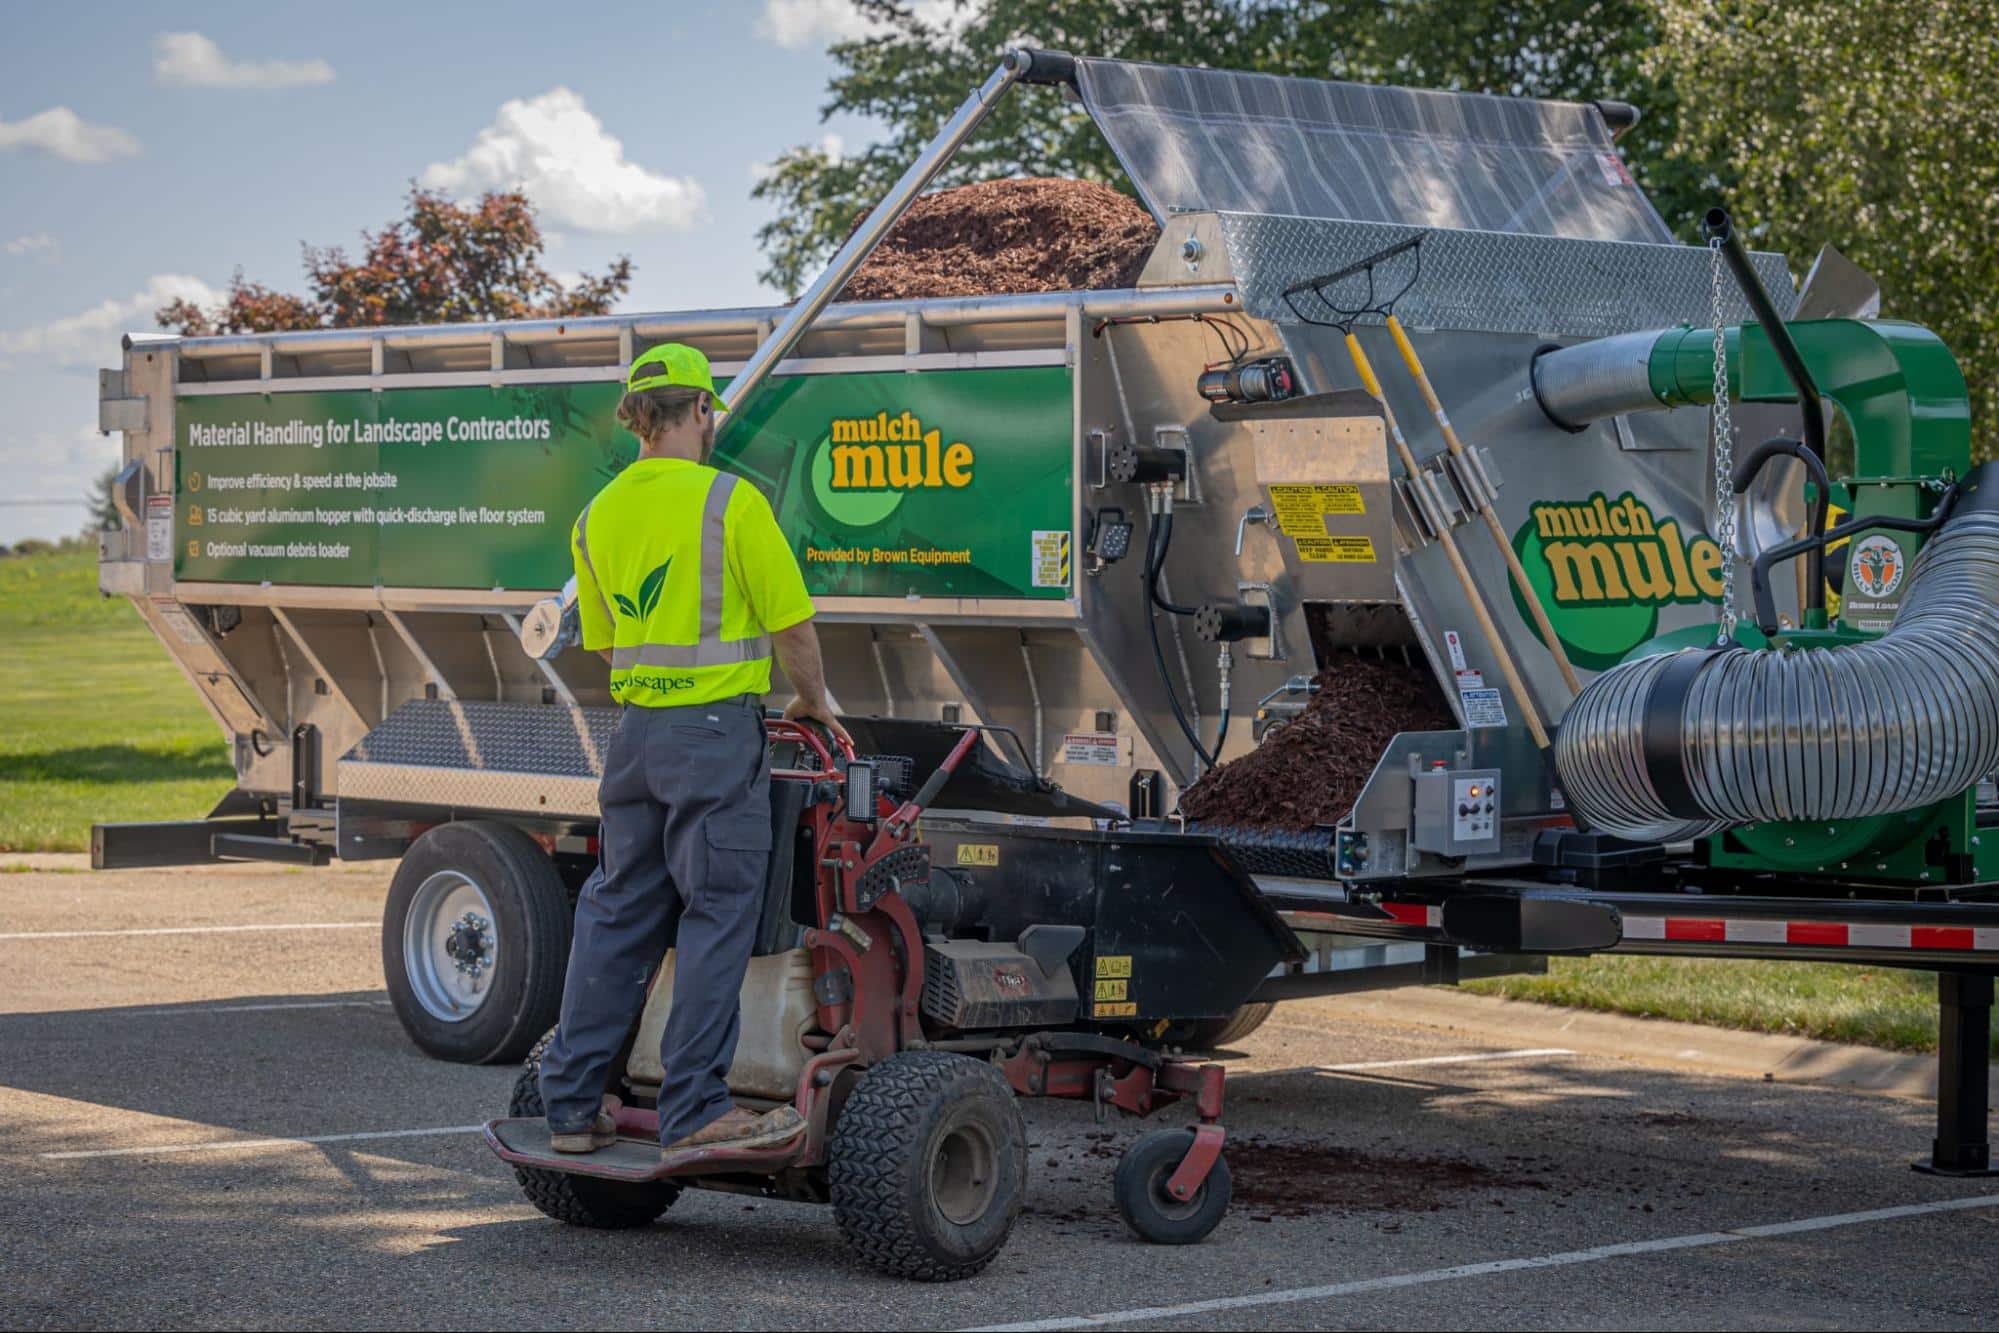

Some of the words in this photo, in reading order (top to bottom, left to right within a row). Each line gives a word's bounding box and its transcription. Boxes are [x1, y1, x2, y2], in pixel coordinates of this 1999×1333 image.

[189, 421, 250, 446] Material
[253, 420, 323, 448] Handling
[327, 419, 350, 443] for
[354, 417, 442, 446] Landscape
[447, 416, 550, 441] Contractors
[831, 411, 921, 442] mulch
[831, 429, 974, 488] mule
[207, 474, 244, 491] Improve
[246, 473, 291, 491] efficiency
[293, 473, 300, 488] &
[303, 472, 332, 491] speed
[333, 474, 344, 487] at
[345, 472, 361, 487] the
[362, 472, 397, 490] jobsite
[207, 508, 217, 523] 15
[218, 507, 243, 523] cubic
[244, 508, 266, 526] yard
[268, 508, 314, 523] aluminum
[316, 507, 351, 526] hopper
[353, 507, 375, 523] with
[376, 507, 456, 526] quick-discharge
[459, 507, 477, 523] live
[479, 507, 504, 523] floor
[506, 508, 545, 526] system
[1535, 497, 1656, 537] mulch
[207, 541, 247, 559] Optional
[249, 544, 285, 558] vacuum
[287, 542, 317, 558] debris
[318, 542, 350, 558] loader
[807, 547, 854, 562] Provided
[856, 547, 870, 565] by
[873, 548, 908, 563] Brown
[910, 548, 971, 565] Equipment
[1545, 522, 1725, 600] mule
